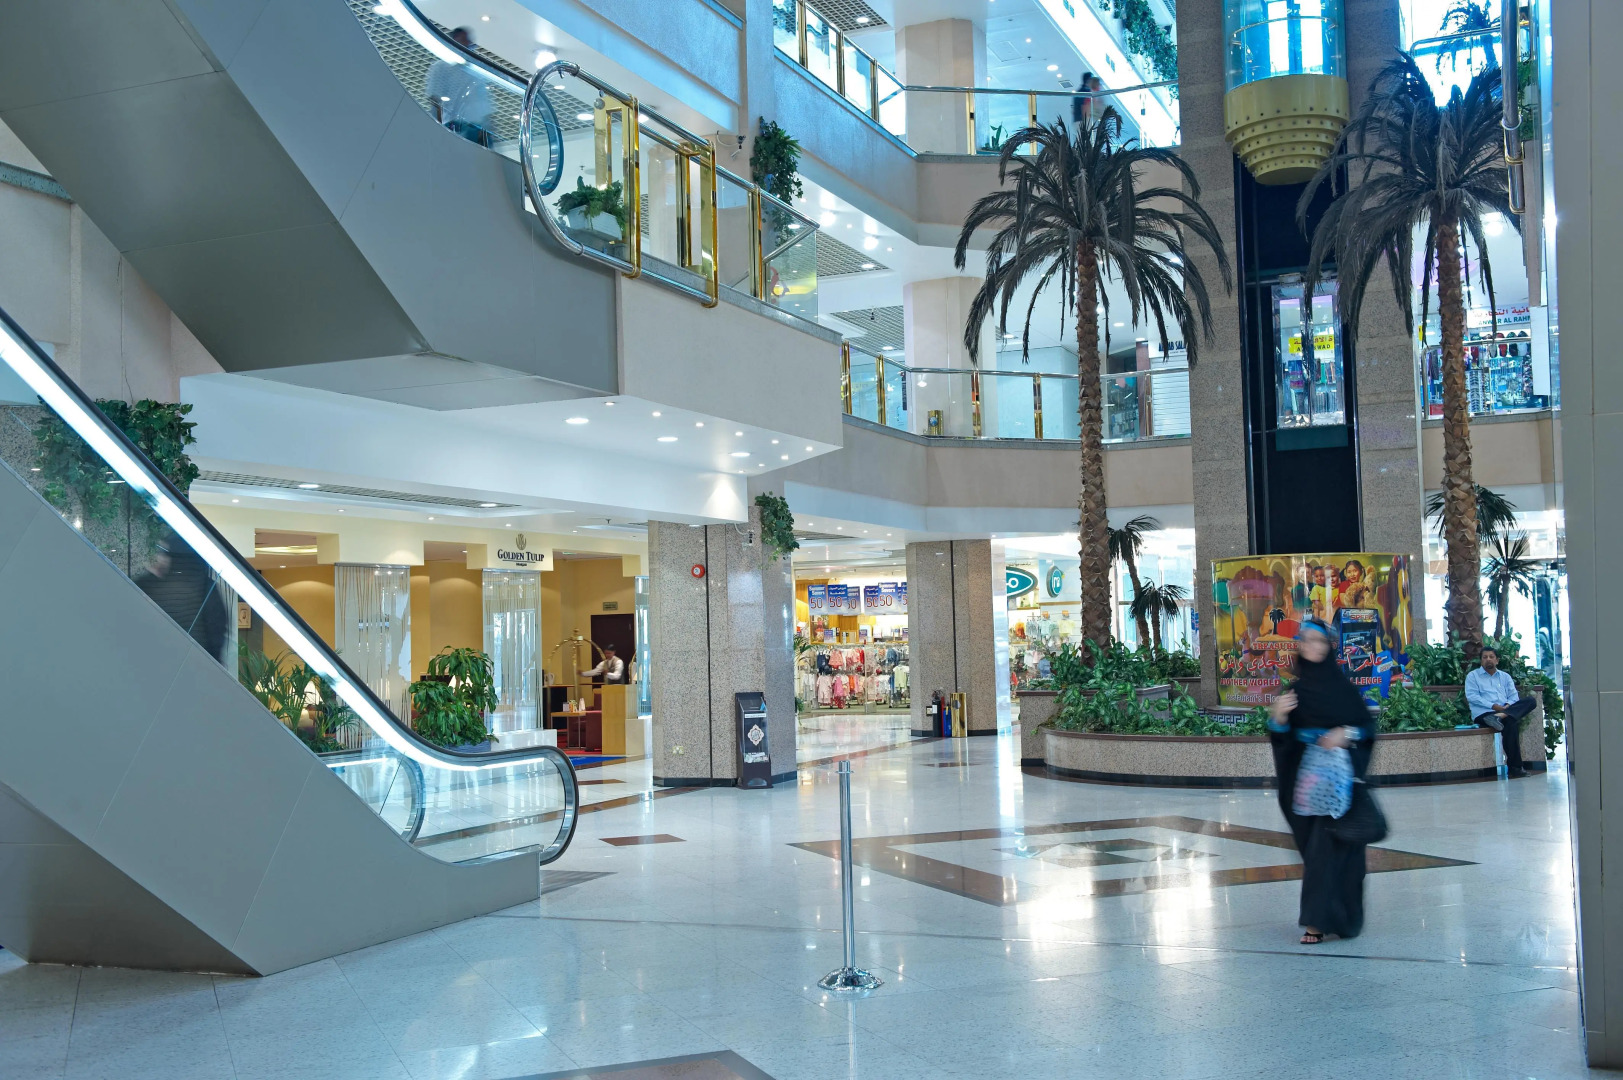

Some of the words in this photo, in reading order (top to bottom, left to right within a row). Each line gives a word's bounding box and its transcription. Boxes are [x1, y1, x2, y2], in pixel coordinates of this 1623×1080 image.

[497, 548, 525, 560] GOLDEN
[526, 551, 545, 562] TULIP
[810, 597, 823, 609] 50
[829, 596, 843, 608] 50
[879, 594, 893, 607] 50
[1252, 642, 1298, 650] TREASURE
[1249, 677, 1281, 687] WORLD
